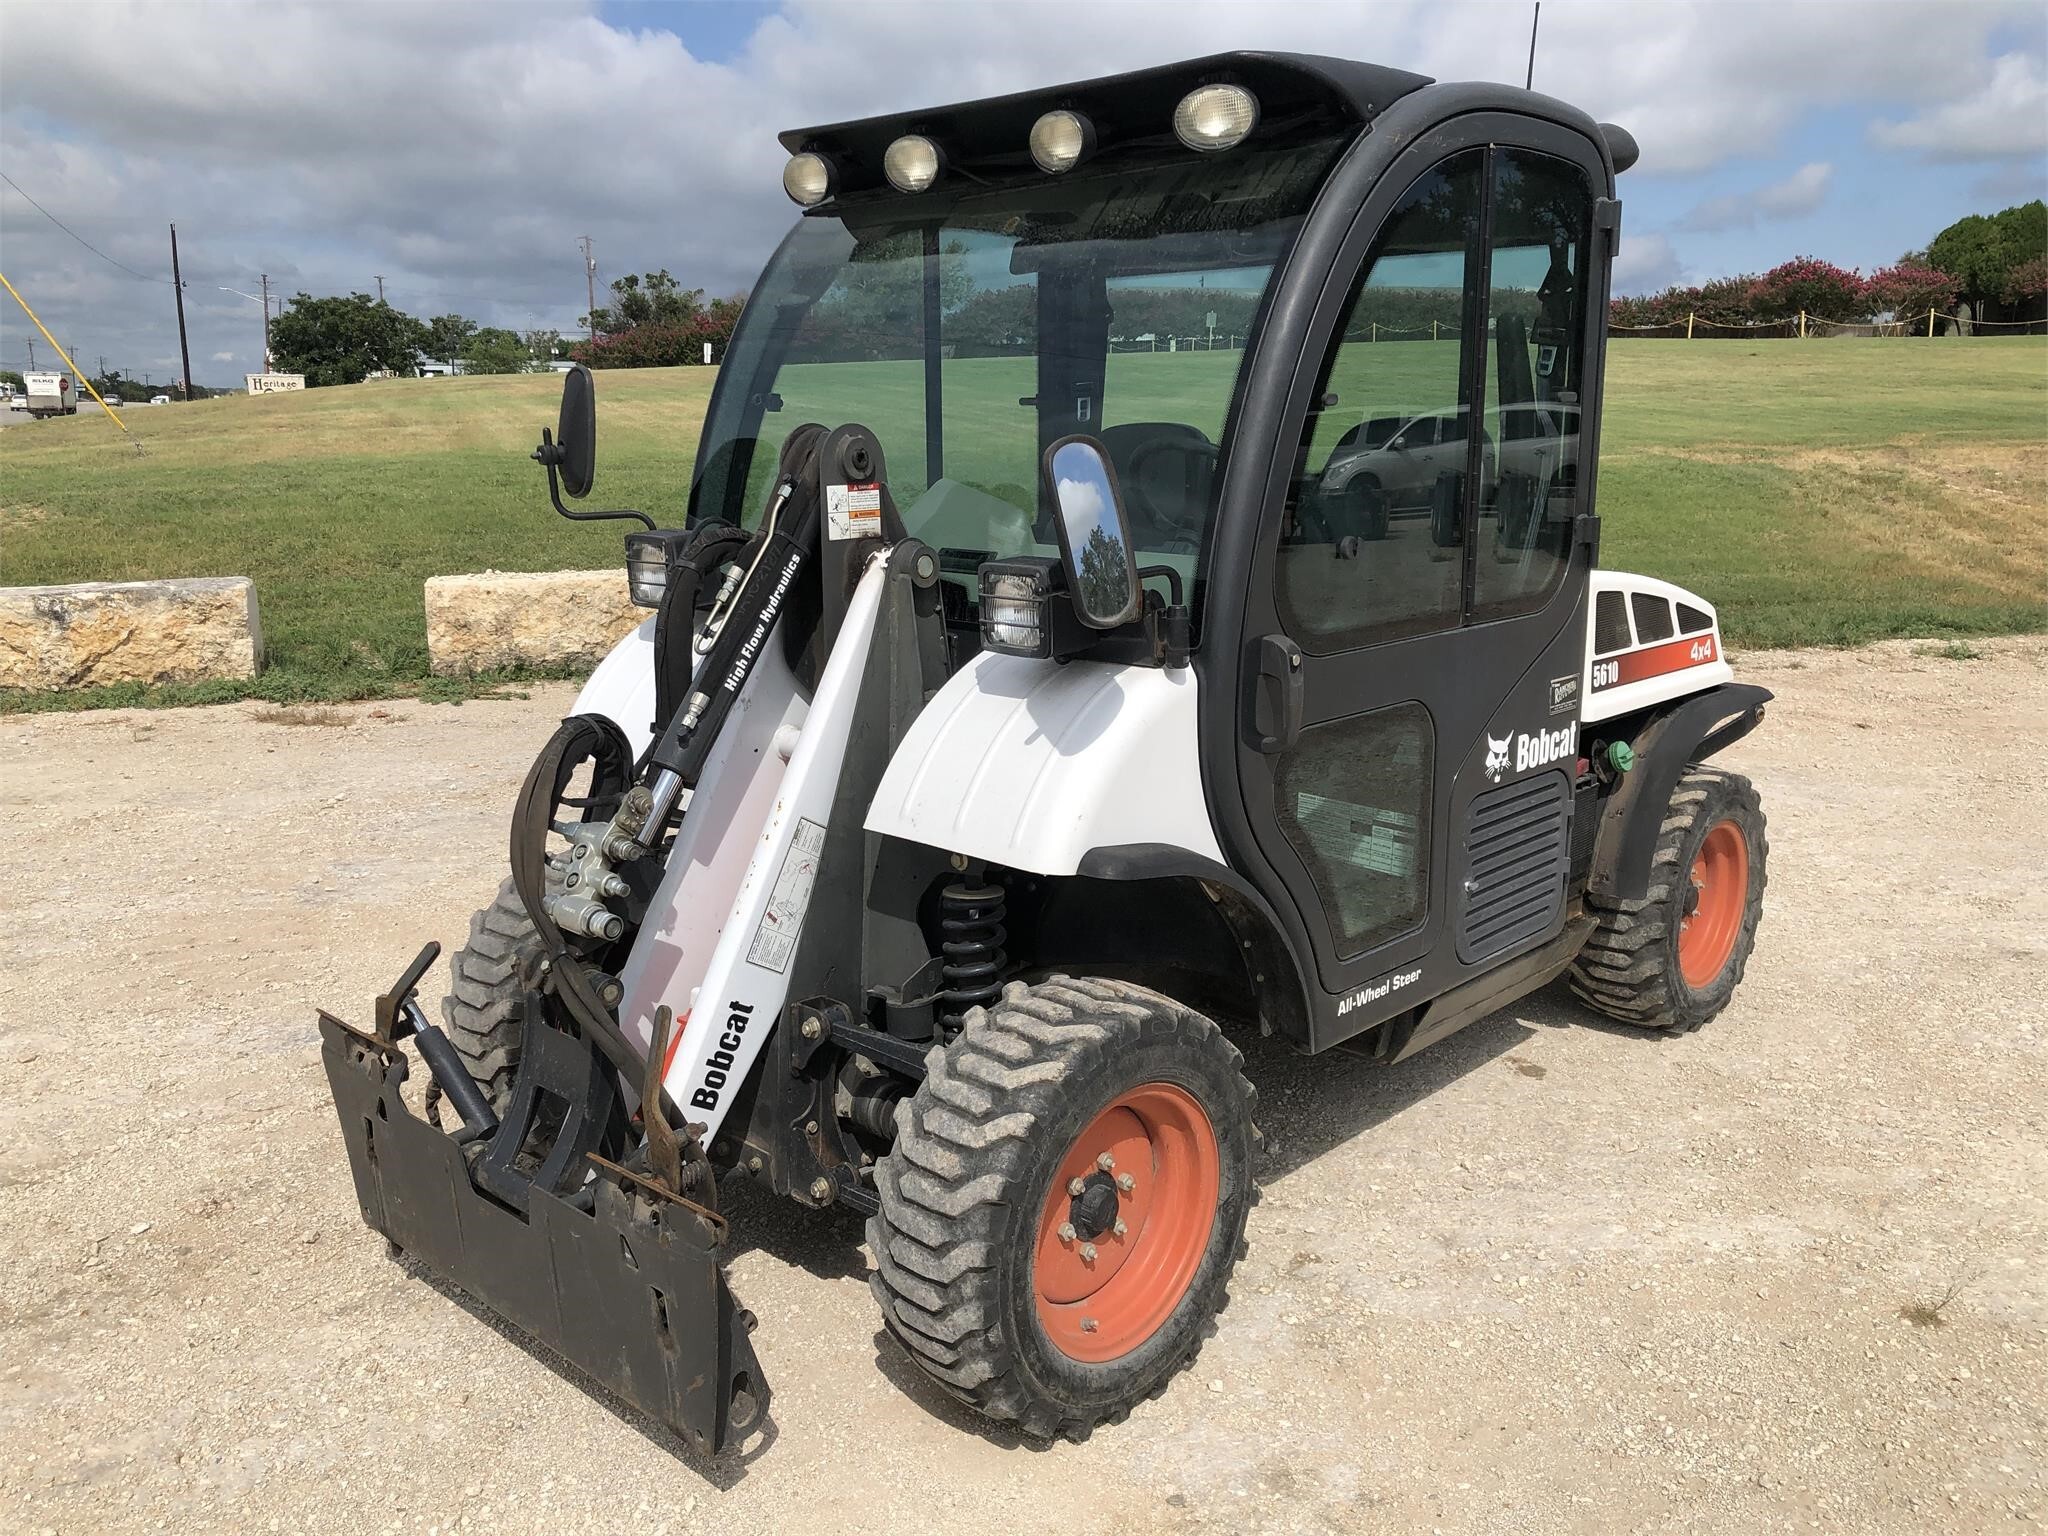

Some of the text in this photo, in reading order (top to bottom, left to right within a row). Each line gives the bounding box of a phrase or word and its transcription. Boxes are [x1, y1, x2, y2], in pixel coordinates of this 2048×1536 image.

[252, 378, 297, 390] Heritage
[724, 657, 748, 692] High
[741, 623, 765, 658] Flow
[759, 553, 800, 623] Hydraulics
[1593, 660, 1618, 688] 5610
[1690, 639, 1711, 661] 4x4
[1516, 720, 1576, 773] Bobcat
[1337, 969, 1422, 1017] All-Wheel Steer
[690, 1000, 754, 1111] Bobcat
